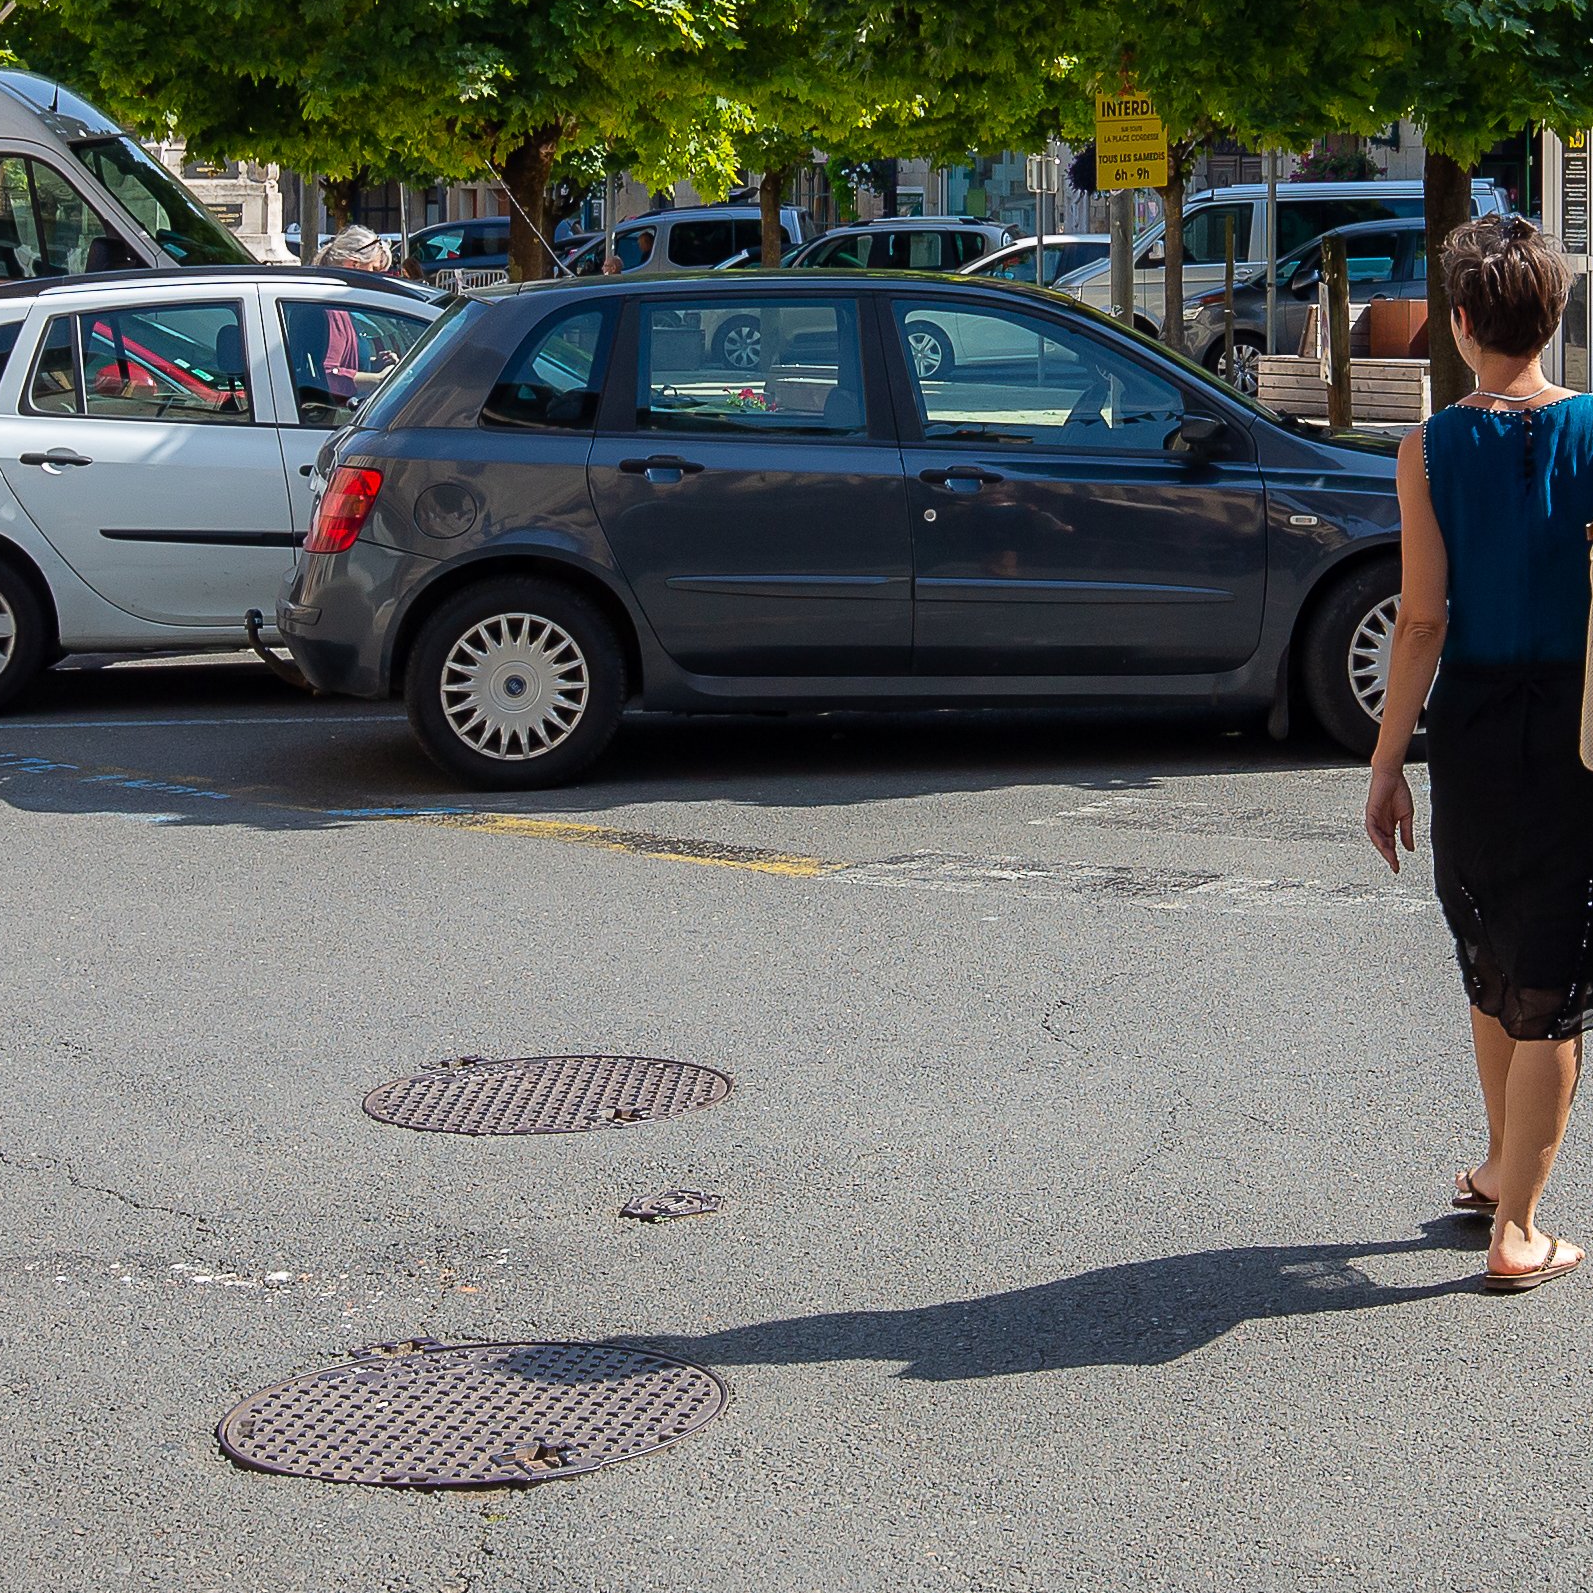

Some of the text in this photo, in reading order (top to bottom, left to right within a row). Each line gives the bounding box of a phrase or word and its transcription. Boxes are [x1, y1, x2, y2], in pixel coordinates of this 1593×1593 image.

[1101, 99, 1155, 117] INTERDI
[1112, 134, 1130, 142] PLACE
[1098, 152, 1165, 164] TOUS LES SAMEDIS
[1114, 169, 1127, 181] 6h
[1136, 168, 1149, 180] 9h
